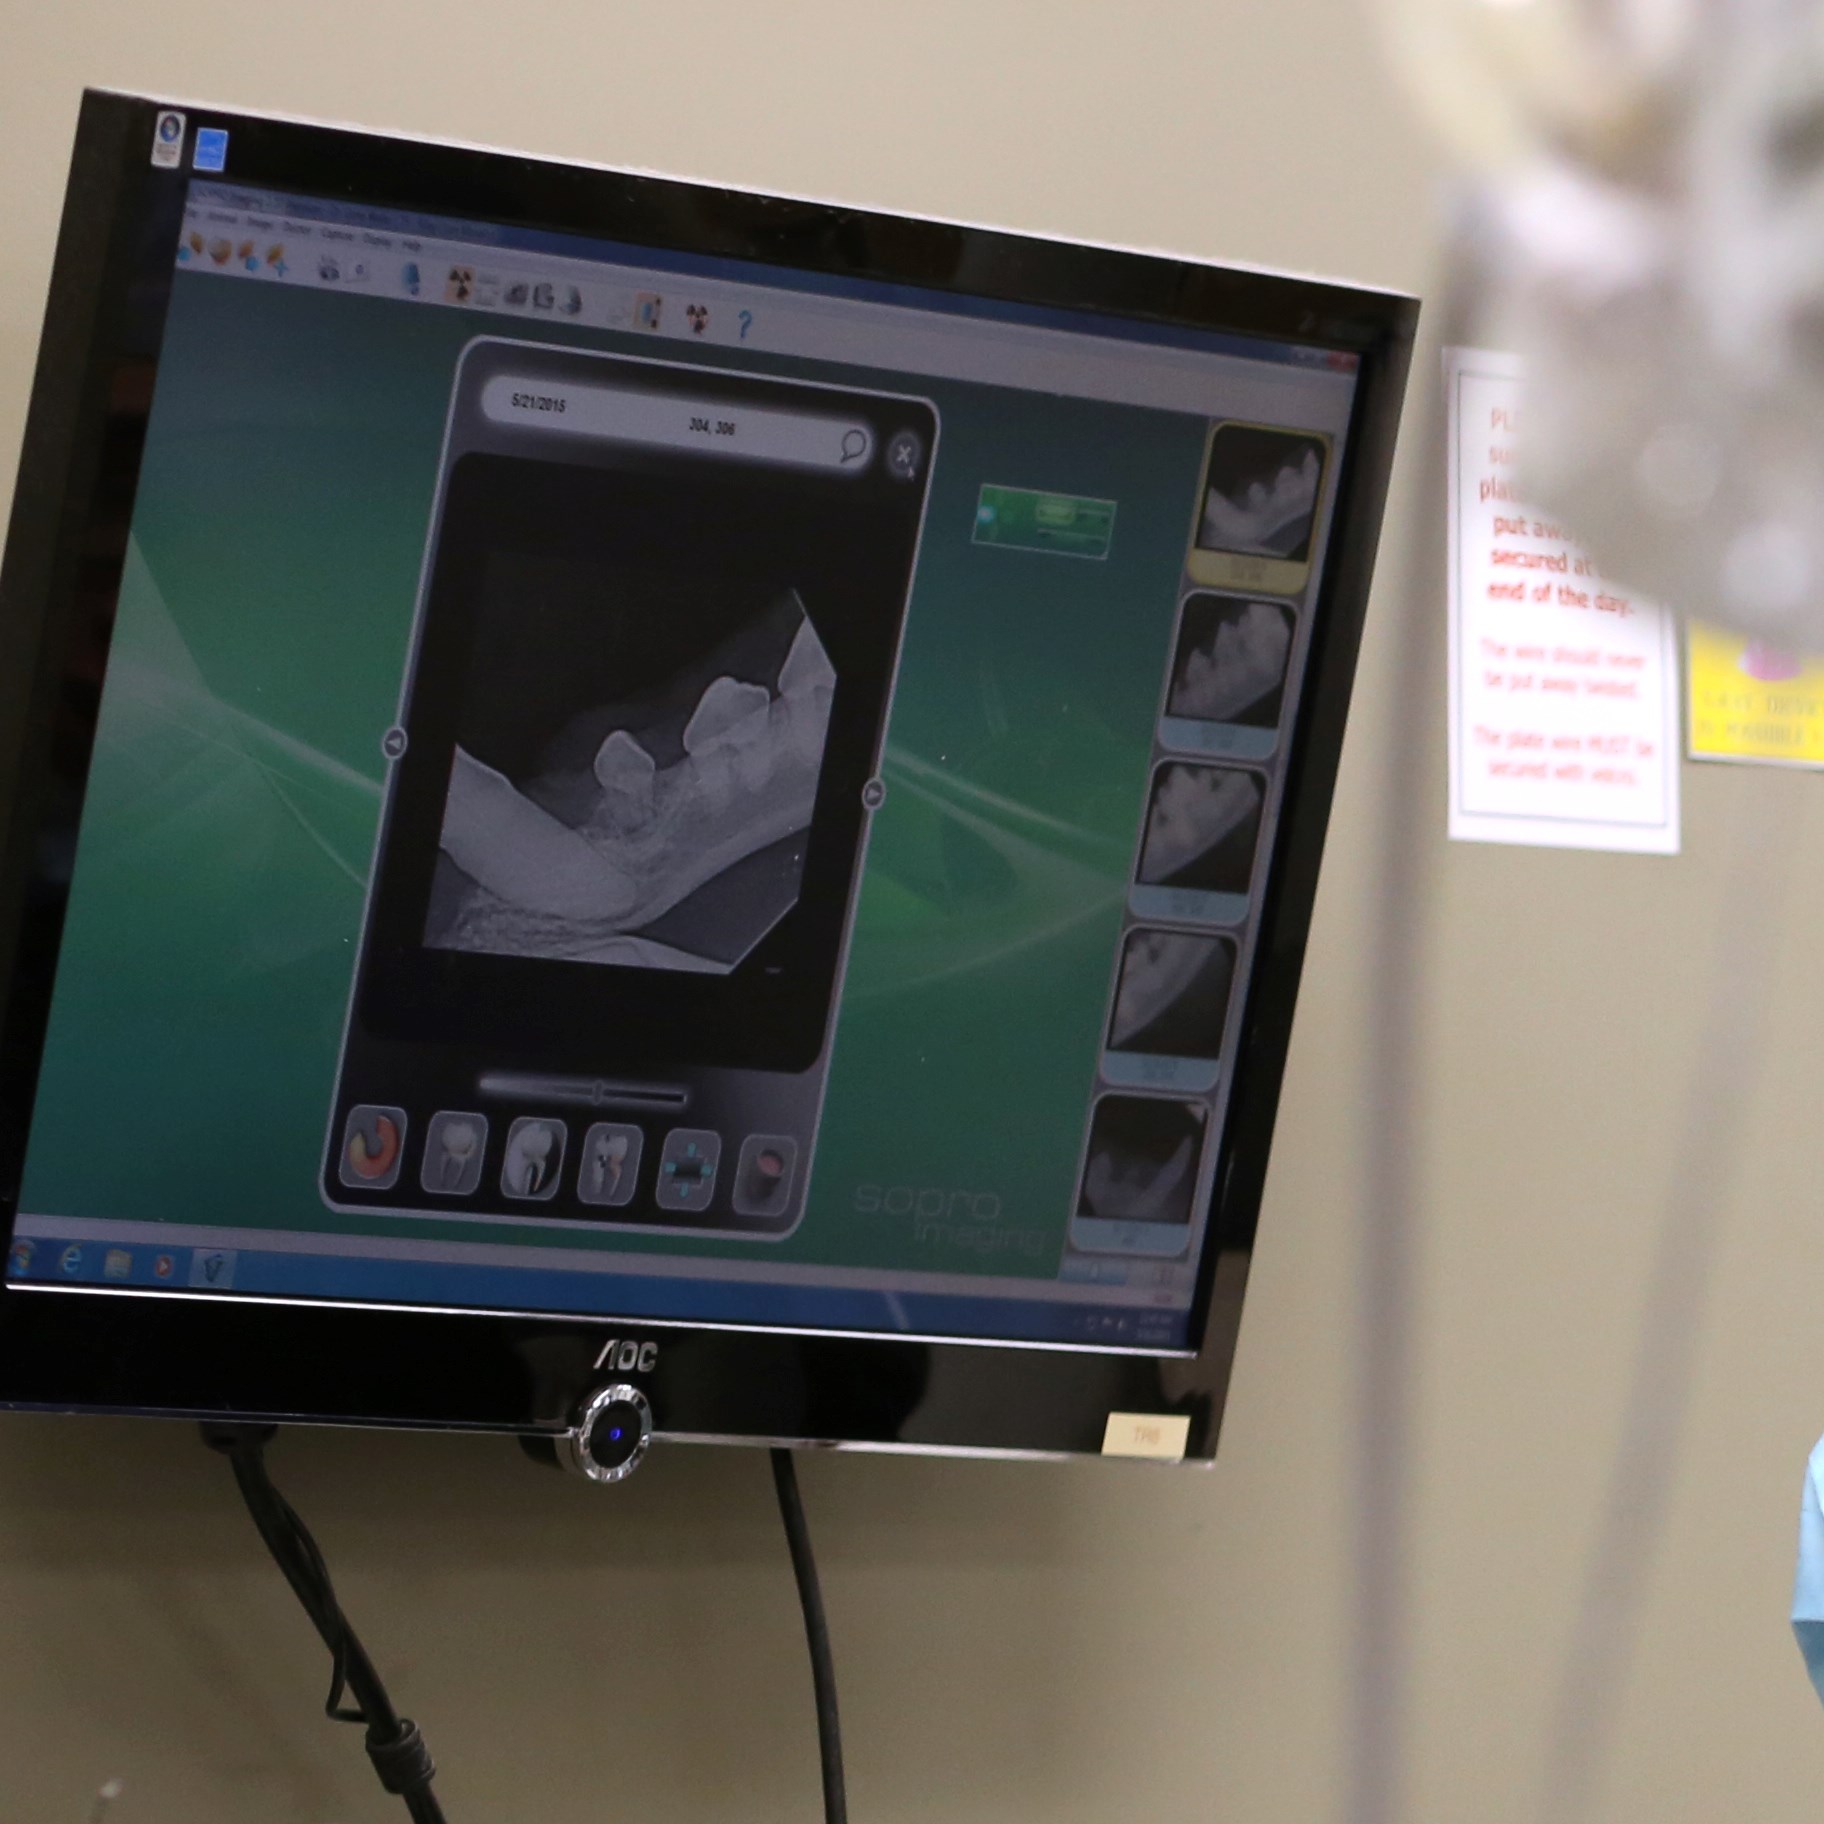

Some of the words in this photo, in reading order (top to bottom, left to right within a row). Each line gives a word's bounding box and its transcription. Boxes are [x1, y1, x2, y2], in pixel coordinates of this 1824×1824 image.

[1494, 516, 1527, 537] put
[1491, 550, 1567, 574] secured
[1488, 582, 1524, 601] end
[1532, 583, 1551, 602] of
[1558, 584, 1589, 608] the
[593, 1339, 658, 1372] AOC
